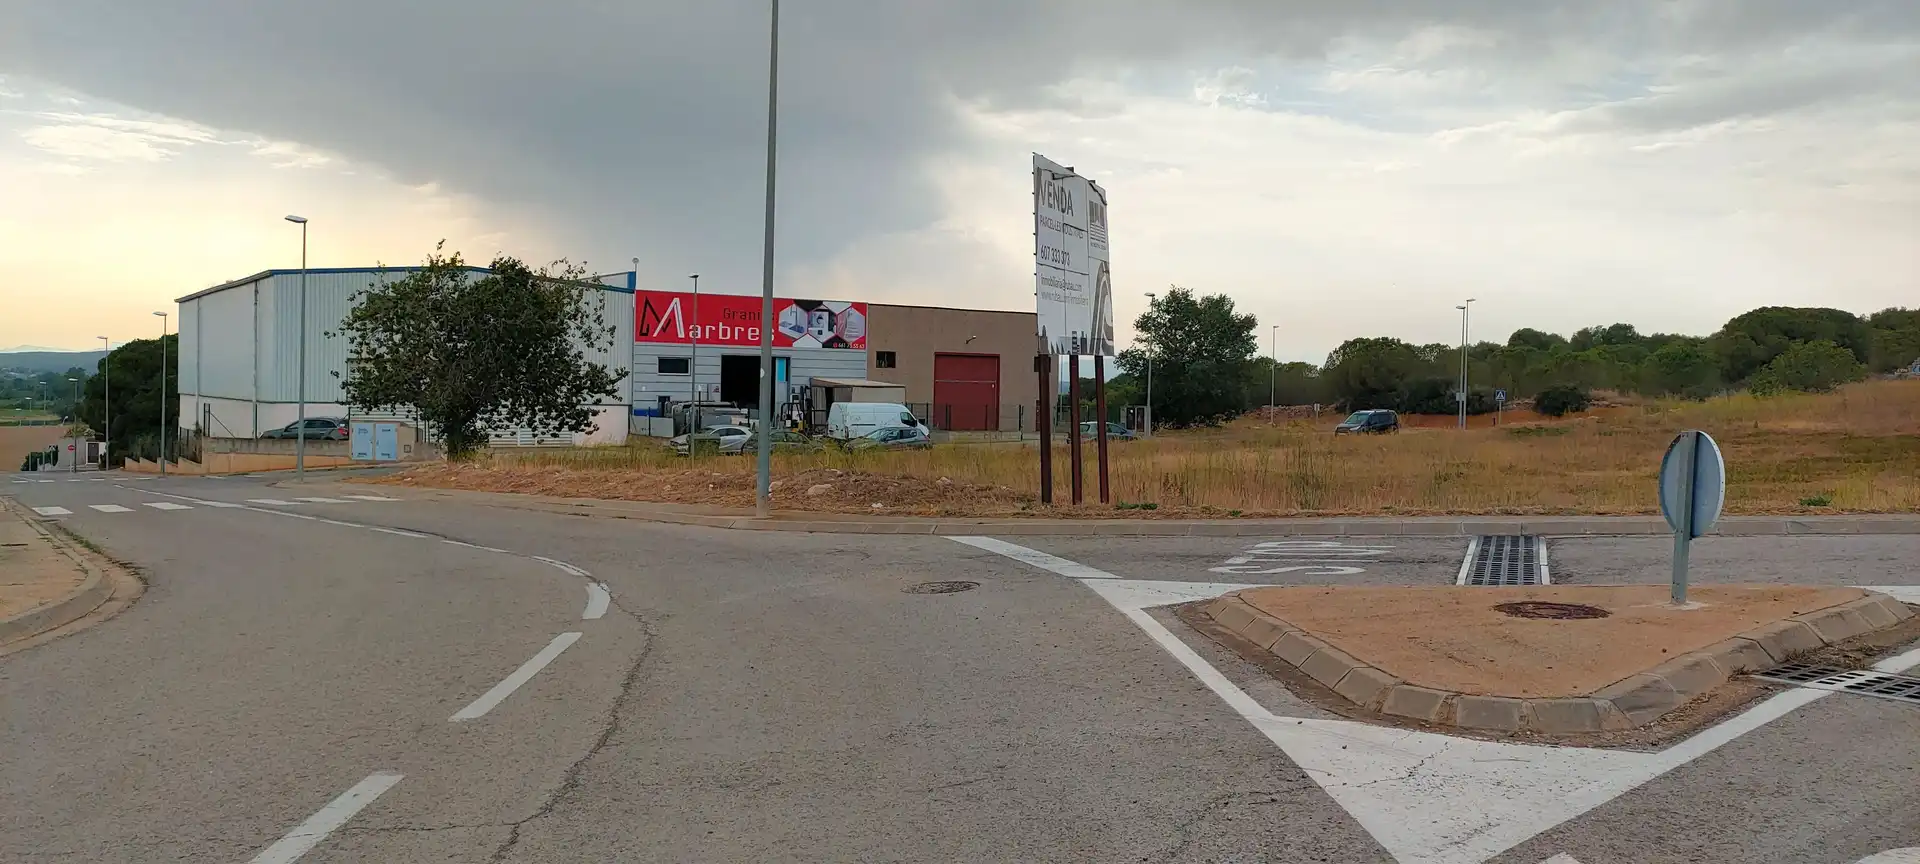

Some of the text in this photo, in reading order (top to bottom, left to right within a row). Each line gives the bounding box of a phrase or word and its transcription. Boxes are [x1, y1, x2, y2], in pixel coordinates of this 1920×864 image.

[1039, 180, 1074, 217] VENDA
[1040, 245, 1050, 261] 607
[1051, 248, 1060, 264] 333
